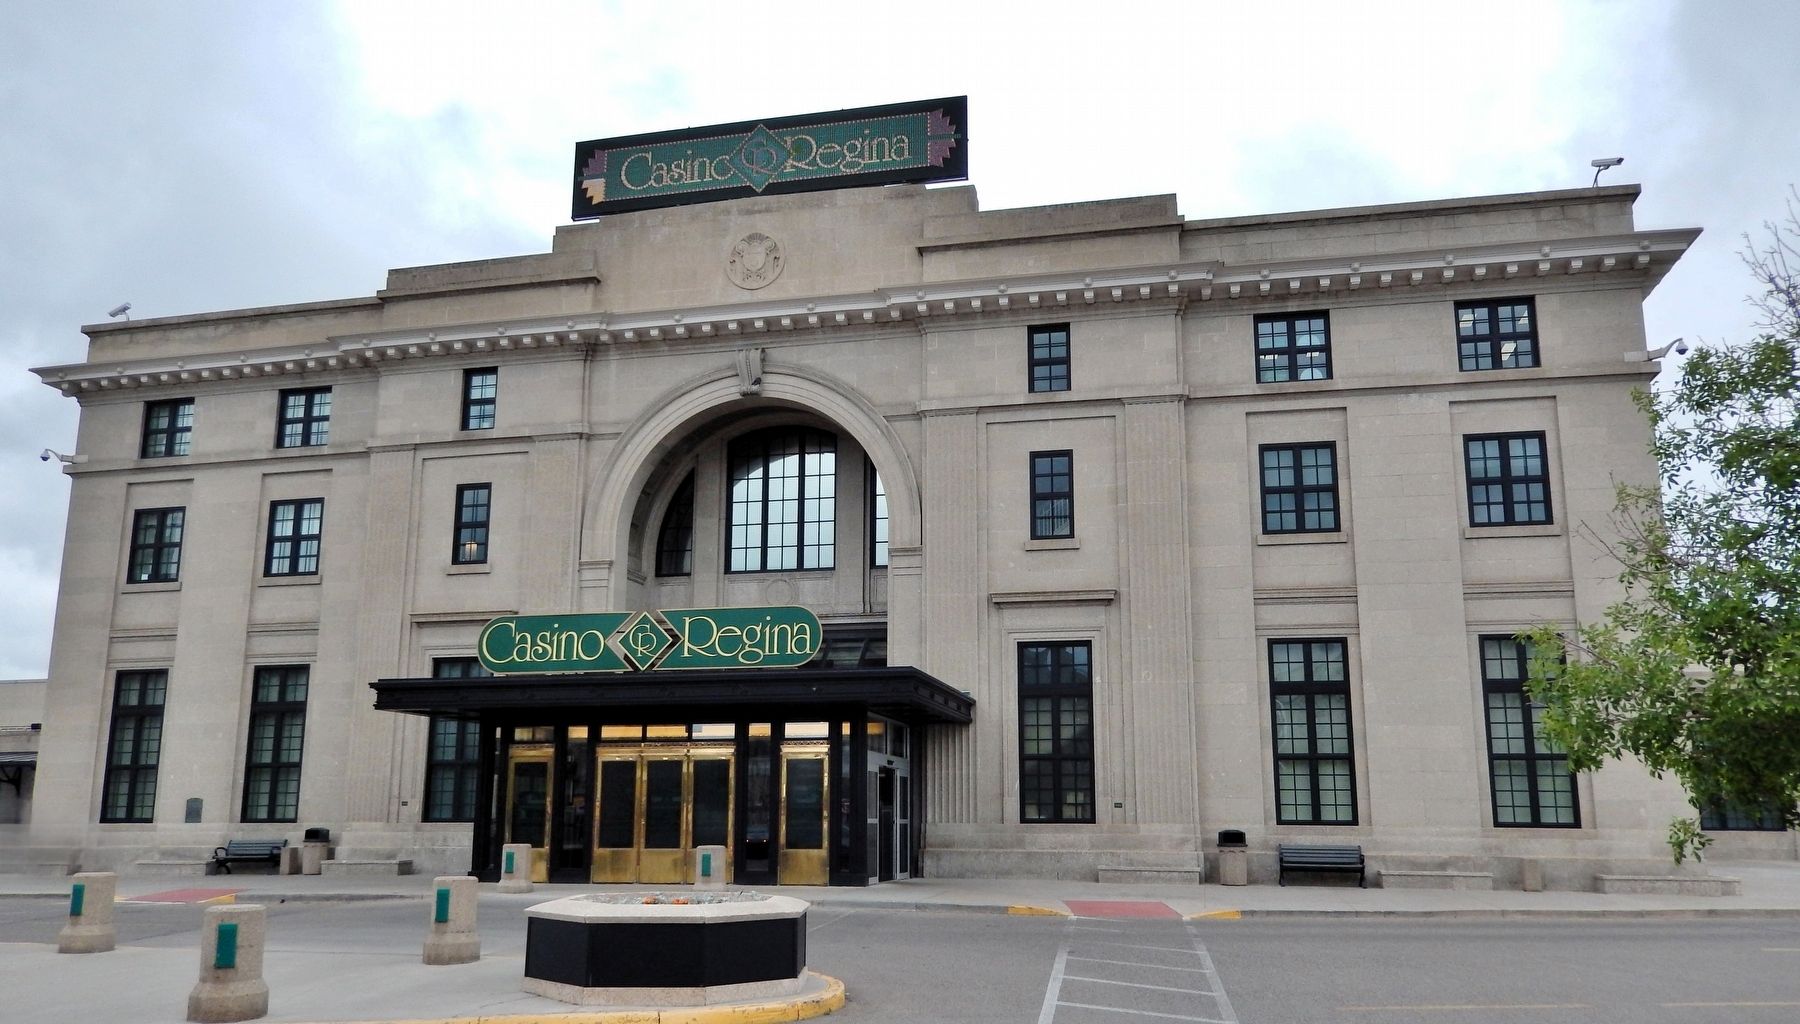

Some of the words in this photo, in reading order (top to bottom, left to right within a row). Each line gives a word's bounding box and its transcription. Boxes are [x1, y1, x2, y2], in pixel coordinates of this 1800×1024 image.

[620, 149, 735, 190] Casino
[783, 128, 912, 173] Regina
[482, 620, 606, 664] Casino
[681, 615, 814, 664] Regina
